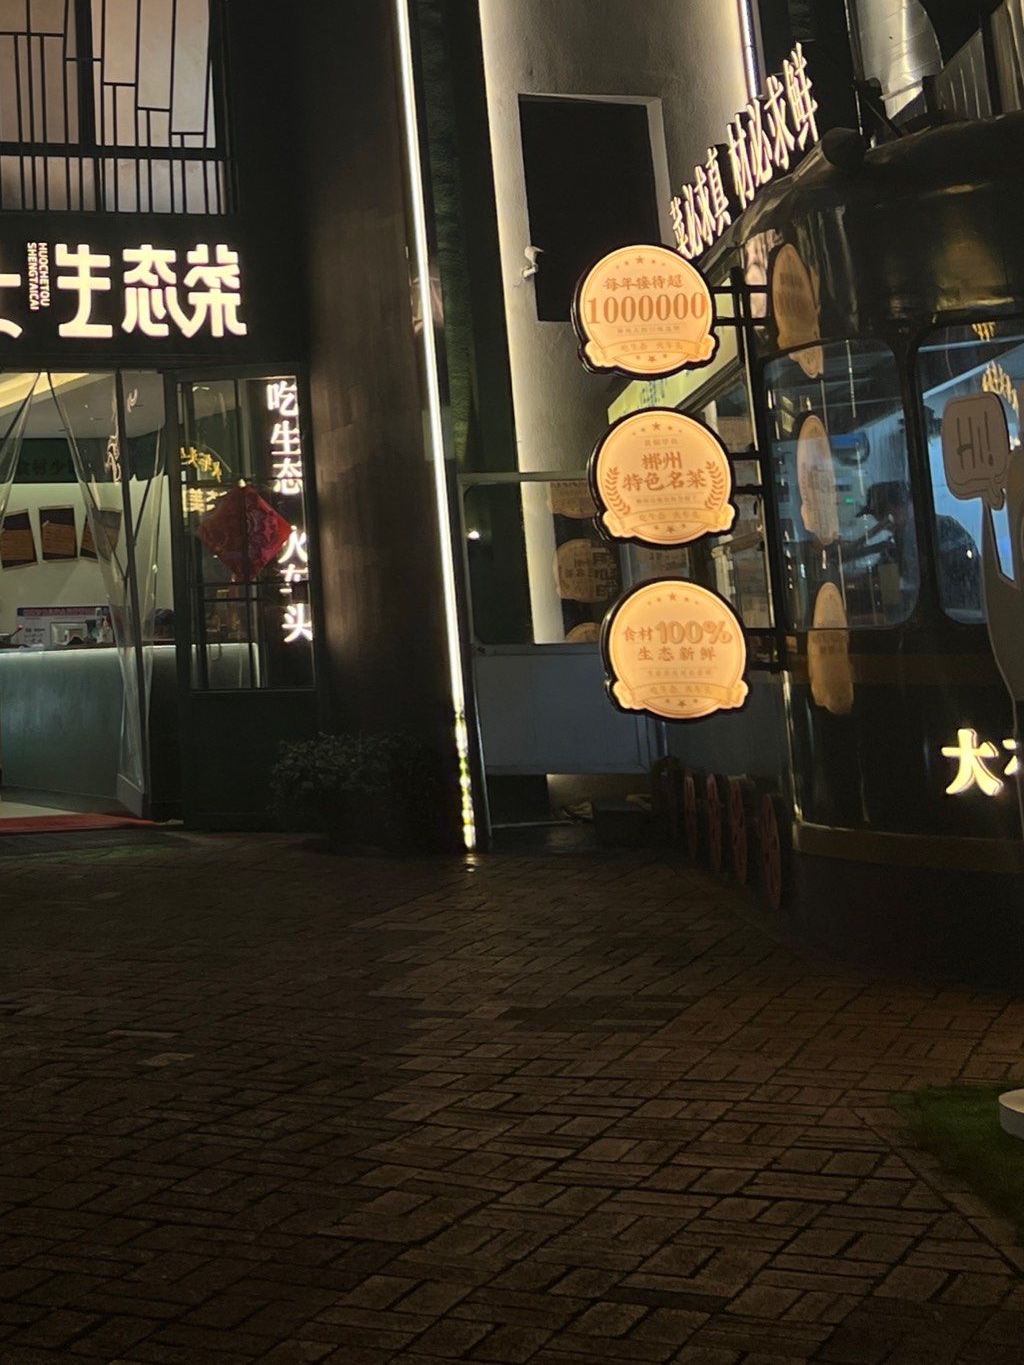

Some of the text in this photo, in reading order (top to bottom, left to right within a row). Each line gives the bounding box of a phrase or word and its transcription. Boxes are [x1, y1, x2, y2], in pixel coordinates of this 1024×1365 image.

[27, 242, 40, 311] SHENGTAICAI
[38, 242, 50, 307] HUOCHETOU
[603, 274, 685, 292] 每年接待超
[587, 292, 707, 325] 1000000
[641, 451, 682, 470] 郴州
[622, 468, 707, 491] 特色名菜
[638, 646, 717, 663] 生态新鲜
